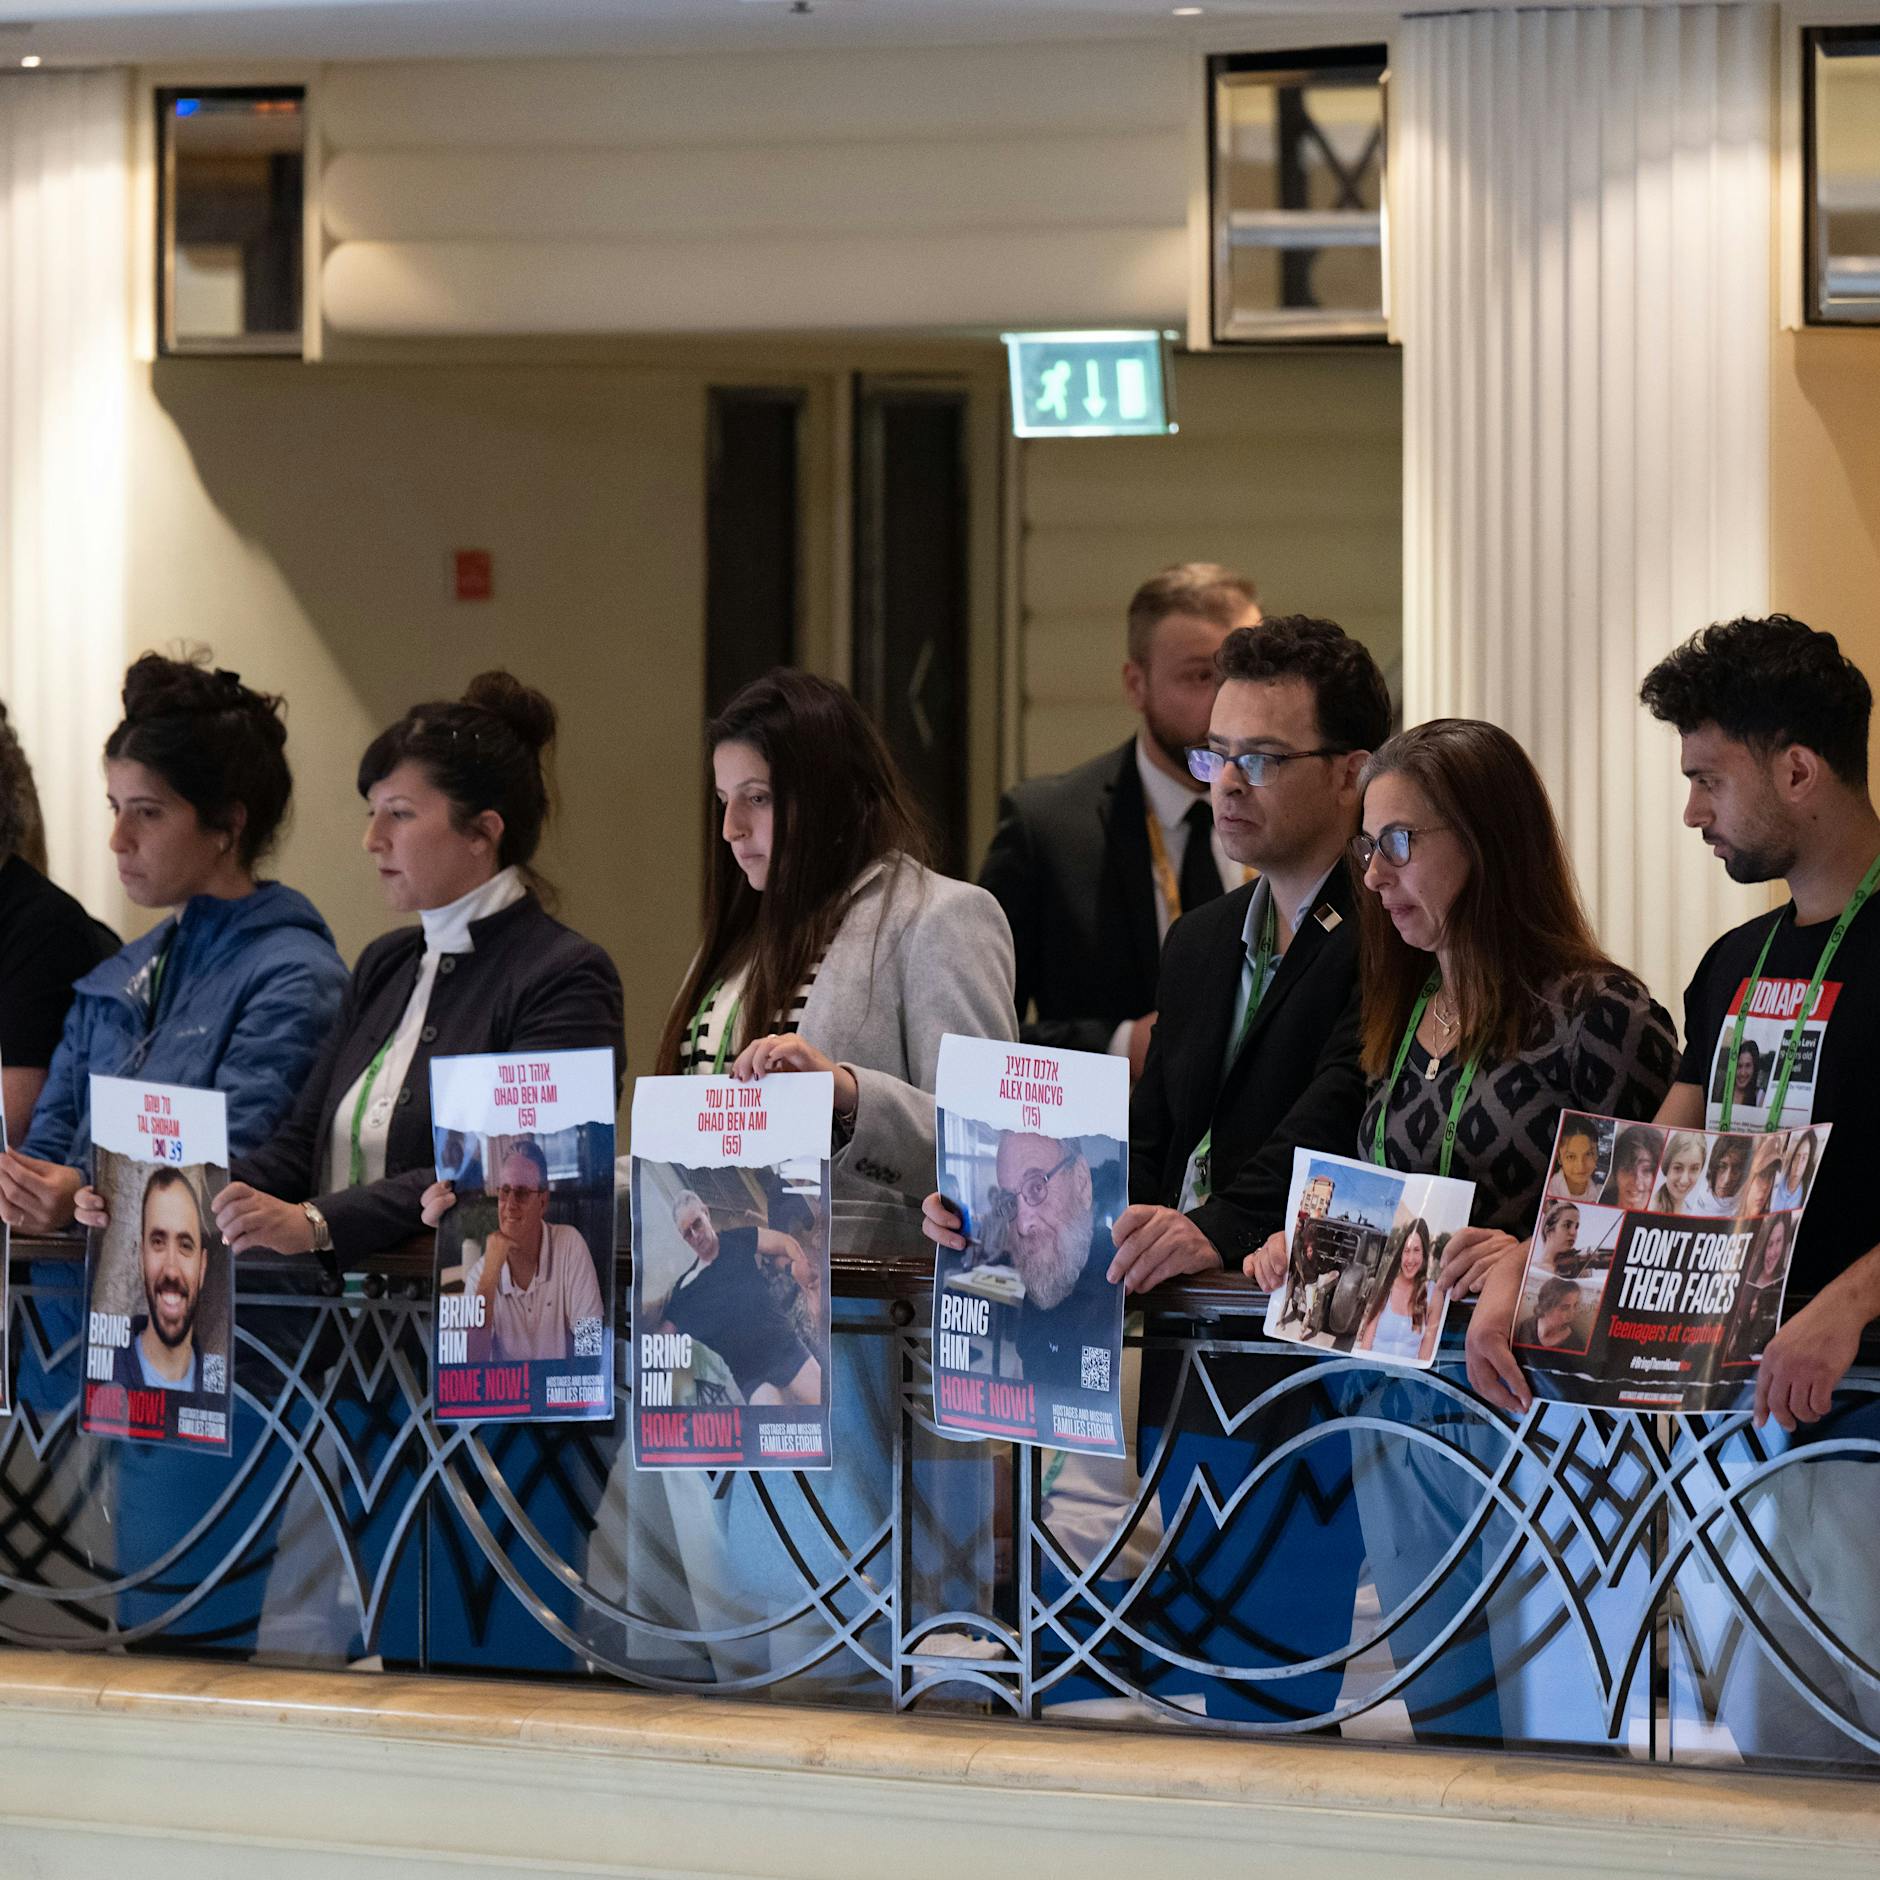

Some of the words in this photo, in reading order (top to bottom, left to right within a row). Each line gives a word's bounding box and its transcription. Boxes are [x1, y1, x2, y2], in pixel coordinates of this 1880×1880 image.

[498, 1065, 515, 1083] עמי
[517, 1064, 527, 1085] בן
[528, 1063, 551, 1082] אוהד
[1005, 1055, 1031, 1078] דנציג
[1033, 1059, 1059, 1081] אלכס
[494, 1087, 519, 1106] OHAD
[521, 1086, 538, 1104] BEN
[541, 1084, 558, 1103] AMI
[706, 1088, 723, 1108] עמי
[726, 1088, 735, 1110] בן
[738, 1087, 762, 1107] אוהד
[1000, 1078, 1022, 1101] ALEX
[1025, 1082, 1063, 1106] DANCYG
[137, 1114, 149, 1133] TAL
[518, 1107, 536, 1128] (55)
[698, 1112, 724, 1132] OHAD
[727, 1111, 746, 1131] BEN
[748, 1111, 767, 1130] AMI
[1022, 1104, 1041, 1129] (75)
[169, 1140, 183, 1162] 39
[722, 1134, 742, 1157] (55)
[1626, 1226, 1694, 1270] DON'T
[1687, 1232, 1753, 1272] FORGET
[1618, 1265, 1683, 1313] THEIR
[1679, 1272, 1741, 1315] FACES
[439, 1294, 486, 1329] BRING
[940, 1294, 990, 1336] BRING
[88, 1311, 131, 1348] BRING
[1608, 1315, 1667, 1345] Teenagers
[1667, 1322, 1682, 1341] at
[438, 1330, 468, 1365] HIM
[641, 1333, 692, 1369] BRING
[939, 1332, 970, 1372] HIM
[87, 1346, 114, 1381] HIM
[438, 1367, 481, 1402] HOME
[485, 1362, 530, 1400] NOW!
[641, 1371, 673, 1406] HIM
[85, 1382, 125, 1419] HOME
[127, 1388, 166, 1426] NOW!
[546, 1387, 579, 1403] FAMILIES
[941, 1374, 985, 1415] HOME
[989, 1381, 1037, 1424] NOW!
[1052, 1404, 1078, 1418] HOSTAGES
[1078, 1408, 1089, 1420] AND
[641, 1411, 689, 1448] HOME
[692, 1407, 742, 1448] NOW!
[1053, 1416, 1087, 1437] FAMILIES
[1087, 1422, 1115, 1441] FORUM
[760, 1435, 795, 1452] FAMILIES
[795, 1435, 823, 1452] FORUM
